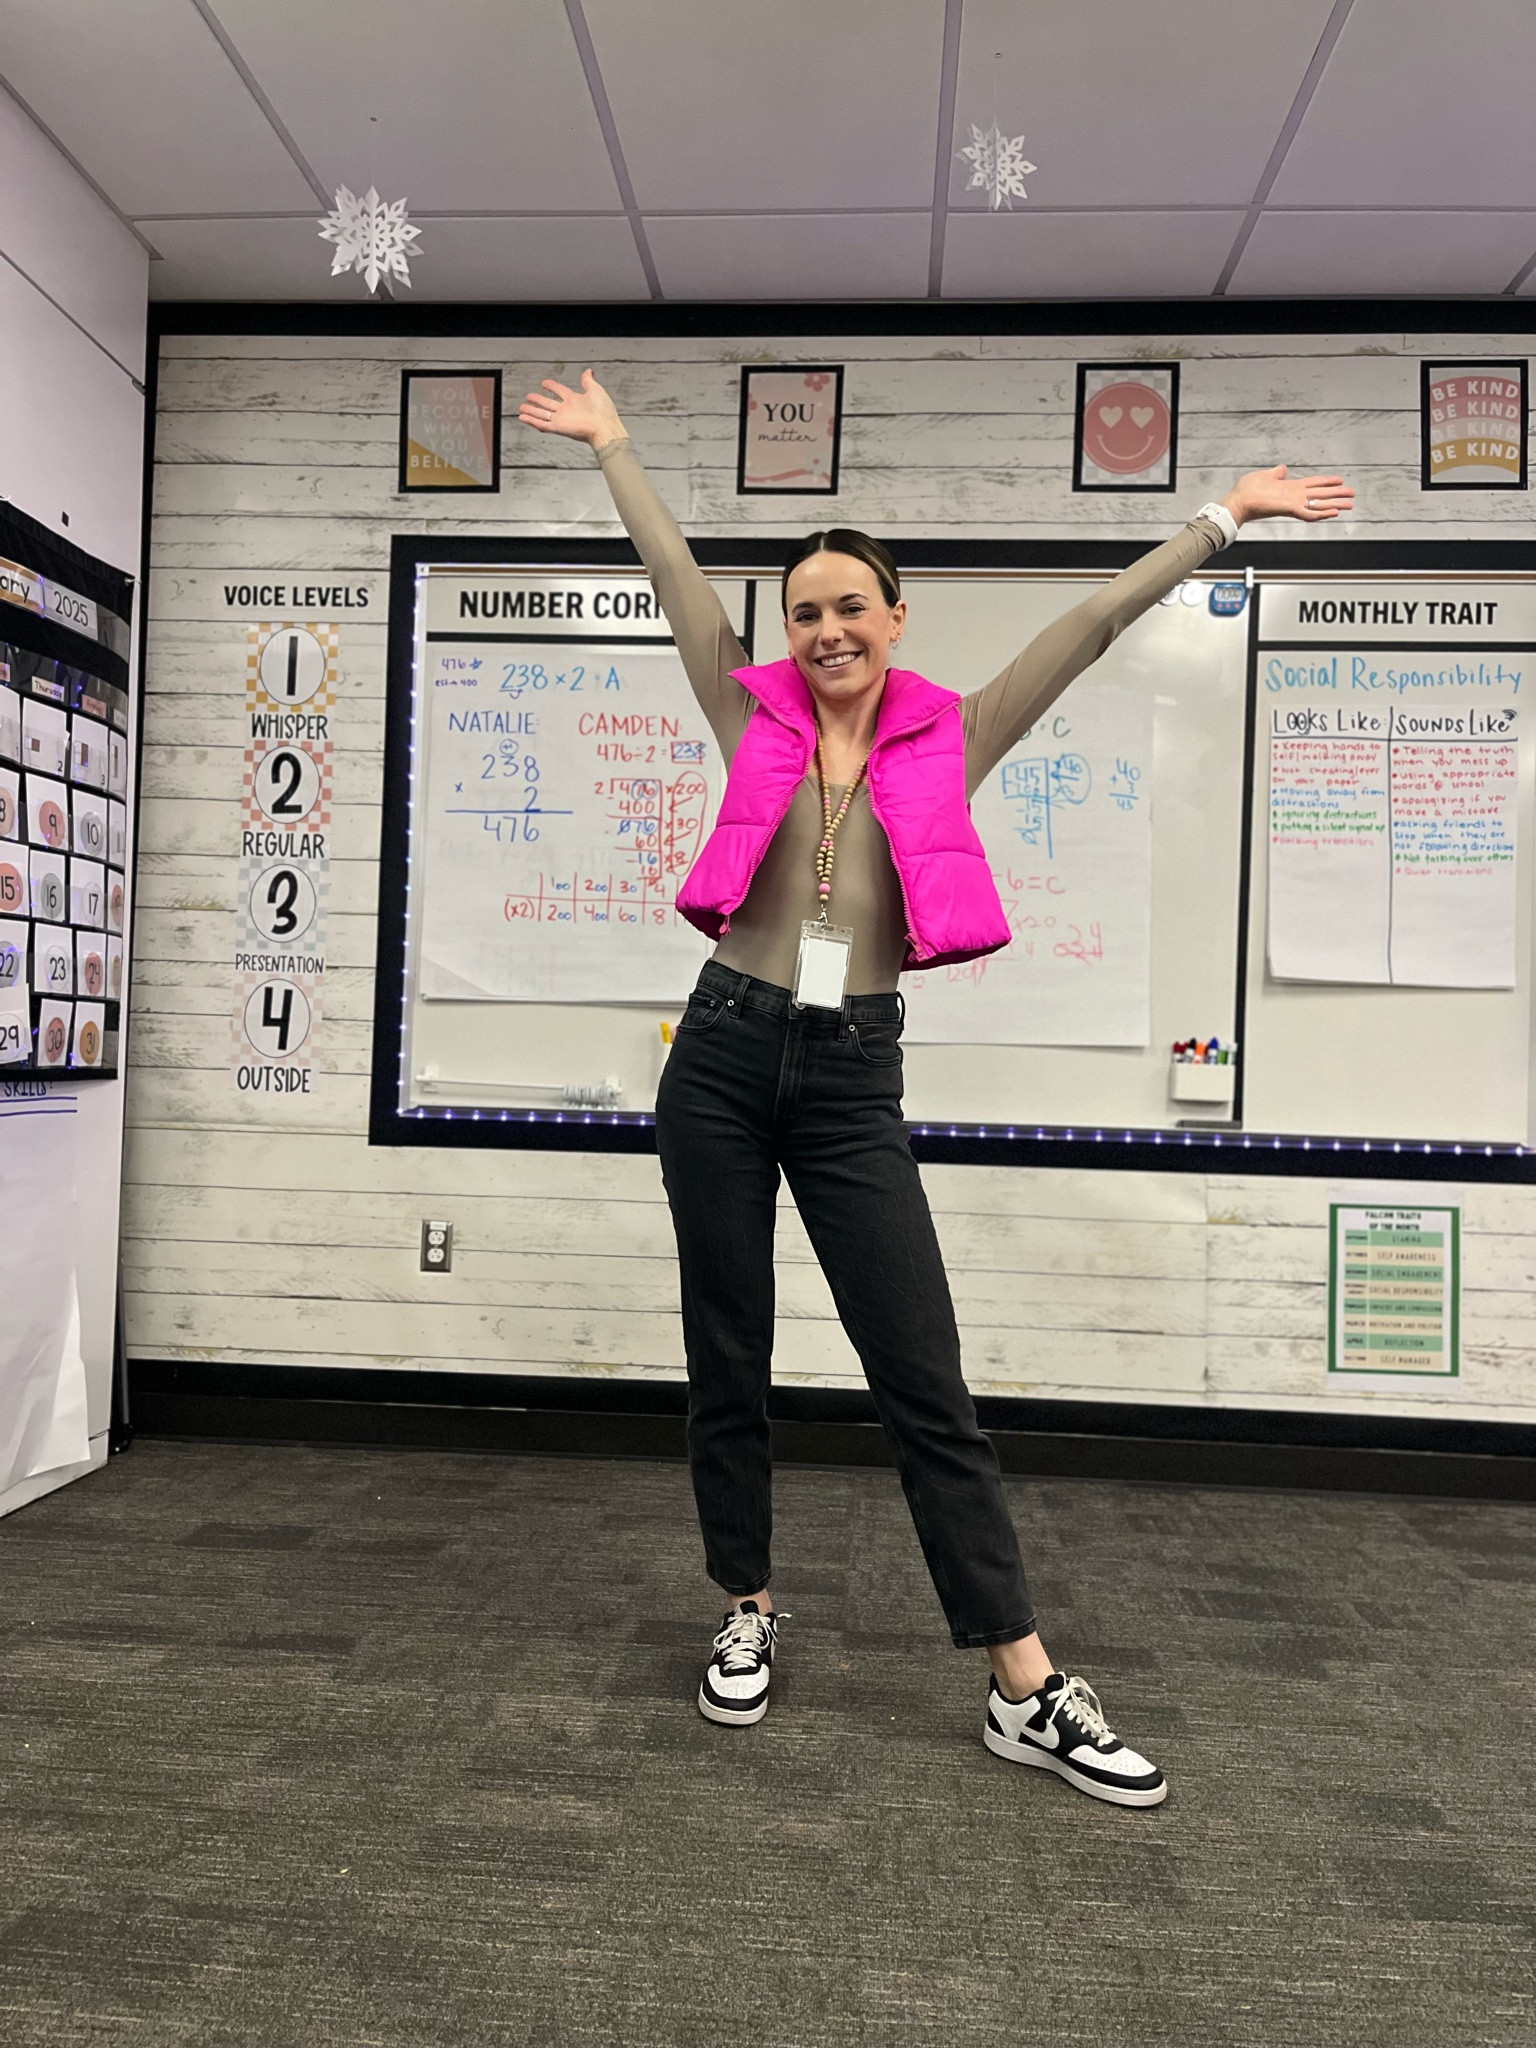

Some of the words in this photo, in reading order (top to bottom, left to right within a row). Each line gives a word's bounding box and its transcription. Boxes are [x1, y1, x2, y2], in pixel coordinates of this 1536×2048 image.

[430, 388, 470, 402] YOU
[1432, 383, 1457, 402] BE
[1467, 380, 1518, 399] KIND
[410, 404, 490, 419] BECOME
[763, 402, 814, 423] YOU
[1432, 403, 1457, 422] BE
[1467, 401, 1518, 419] KIND
[424, 422, 475, 435] WHAT
[758, 428, 817, 442] matter
[1432, 424, 1457, 441] BE
[1467, 422, 1518, 439] KIND
[429, 439, 469, 452] YOU
[1431, 445, 1456, 463] BE
[1467, 442, 1518, 460] KIND
[410, 454, 486, 468] BELIEVE
[224, 586, 286, 607] VOICE
[293, 586, 369, 608] LEVELS
[460, 591, 583, 619] NUMBER
[54, 590, 88, 627] 2025
[1298, 601, 1418, 625] MONTHLY
[1426, 602, 1498, 626] TRAIT
[286, 636, 298, 696] 1
[441, 658, 466, 671] 476
[501, 664, 548, 691] 238
[569, 667, 585, 692] 2
[606, 667, 621, 690] A
[1265, 658, 1337, 692] Social
[1352, 657, 1521, 694] Responsibility
[251, 713, 329, 740] WHISPER
[597, 744, 632, 763] 476
[1282, 742, 1328, 754] Keeping
[1333, 743, 1365, 751] hands
[1403, 746, 1443, 758] Telling
[1449, 746, 1471, 755] the
[1479, 746, 1514, 754] truth
[481, 754, 540, 782] 238
[1393, 758, 1423, 766] when
[1432, 758, 1453, 767] you
[1461, 758, 1489, 766] mess
[1495, 758, 1508, 767] up
[271, 751, 303, 814] 2
[1393, 781, 1427, 790] words
[1452, 780, 1485, 789] school
[1443, 771, 1515, 780] appropriate
[523, 787, 541, 813] 2
[1327, 789, 1357, 800] away
[1361, 786, 1386, 796] from
[1401, 795, 1465, 808] apologizing
[1471, 794, 1480, 802] if
[1488, 795, 1506, 803] you
[1282, 811, 1320, 822] ignoring
[1323, 810, 1377, 819] distractions
[1394, 809, 1427, 817] make
[1452, 807, 1499, 816] mistake
[49, 812, 57, 837] 9
[86, 822, 99, 846] 10
[483, 815, 540, 843] 476
[1281, 822, 1313, 832] putting
[1348, 823, 1373, 834] signal
[1400, 821, 1437, 832] asking
[1443, 819, 1486, 828] friends
[243, 831, 324, 859] REGULAR
[1394, 831, 1416, 840] stop
[1423, 831, 1451, 839] when
[1460, 831, 1487, 841] they
[1403, 853, 1420, 862] Not
[1425, 853, 1461, 864] talking
[1463, 855, 1483, 863] over
[1487, 852, 1514, 862] others
[1419, 841, 1468, 855] following
[0, 876, 15, 901] 15
[46, 884, 57, 908] 16
[88, 893, 99, 917] 17
[267, 870, 299, 935] 3
[50, 957, 66, 980] 23
[88, 962, 101, 985] 24
[235, 954, 324, 973] PRESENTATION
[262, 986, 294, 1050] 4
[48, 1028, 62, 1052] 30
[86, 1033, 97, 1055] 31
[237, 1066, 312, 1093] OUTSIDE
